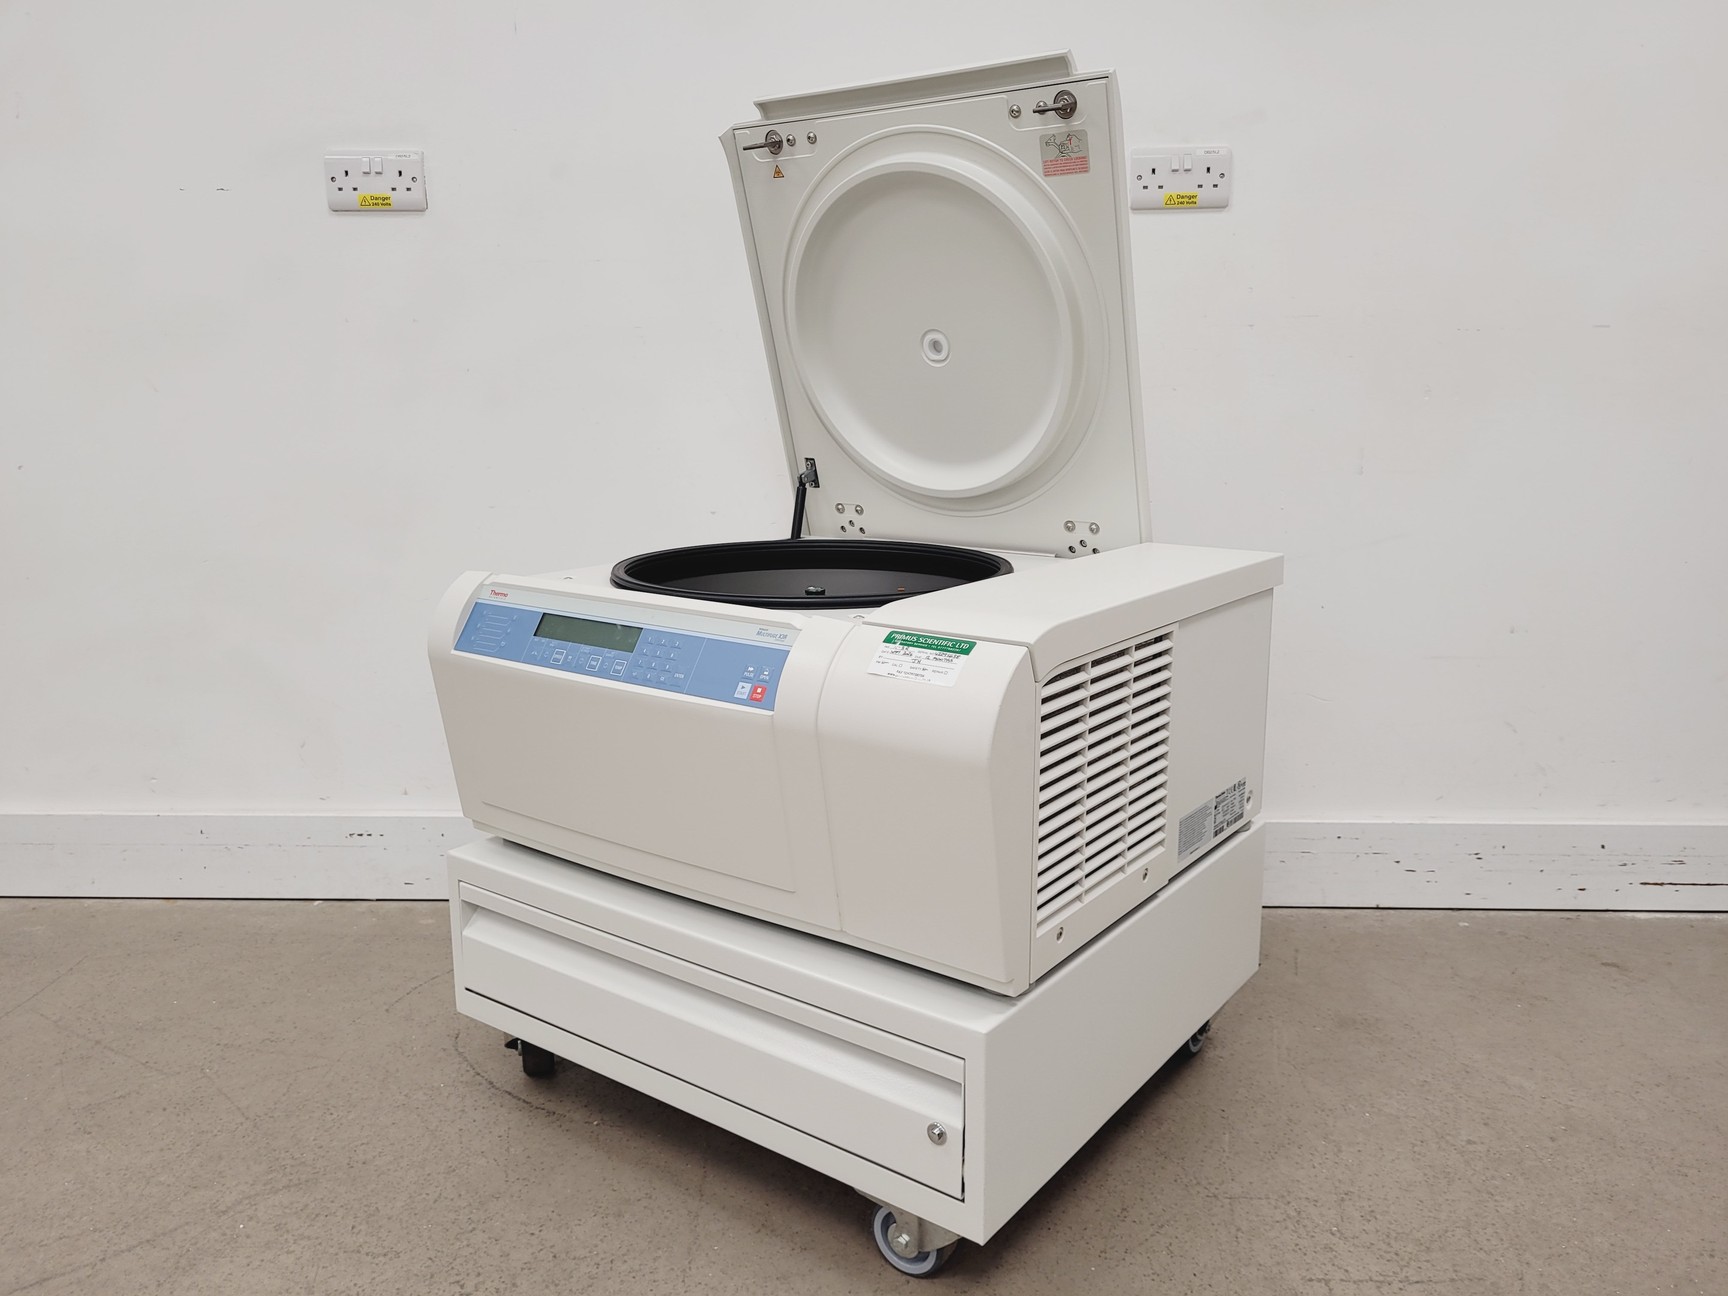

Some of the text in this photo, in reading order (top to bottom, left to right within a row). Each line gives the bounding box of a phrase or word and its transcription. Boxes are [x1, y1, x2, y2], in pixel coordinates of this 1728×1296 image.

[490, 590, 508, 598] Thermo
[891, 634, 917, 642] PRIMUS
[918, 636, 956, 647] SCIENTIFIC
